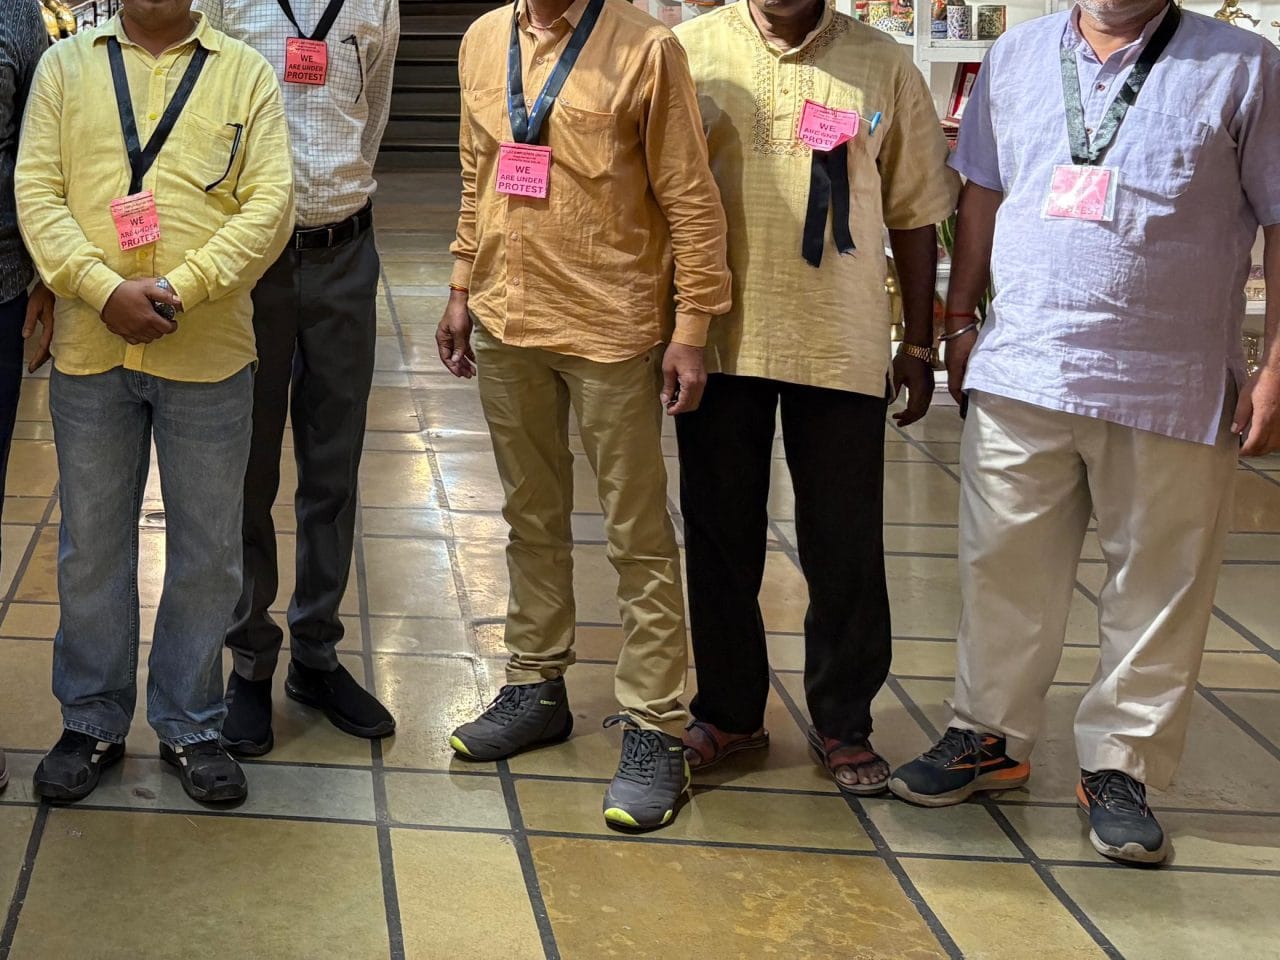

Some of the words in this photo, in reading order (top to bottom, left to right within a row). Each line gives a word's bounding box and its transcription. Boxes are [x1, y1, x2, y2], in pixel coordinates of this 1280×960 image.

[301, 54, 313, 62] WE
[302, 64, 323, 72] UNDER
[287, 71, 323, 81] PROTEST
[820, 123, 837, 132] WE
[515, 165, 531, 174] WE
[516, 176, 543, 184] UNDER
[498, 182, 544, 193] PROTEST
[130, 216, 145, 226] WE
[121, 231, 160, 249] PROTEST
